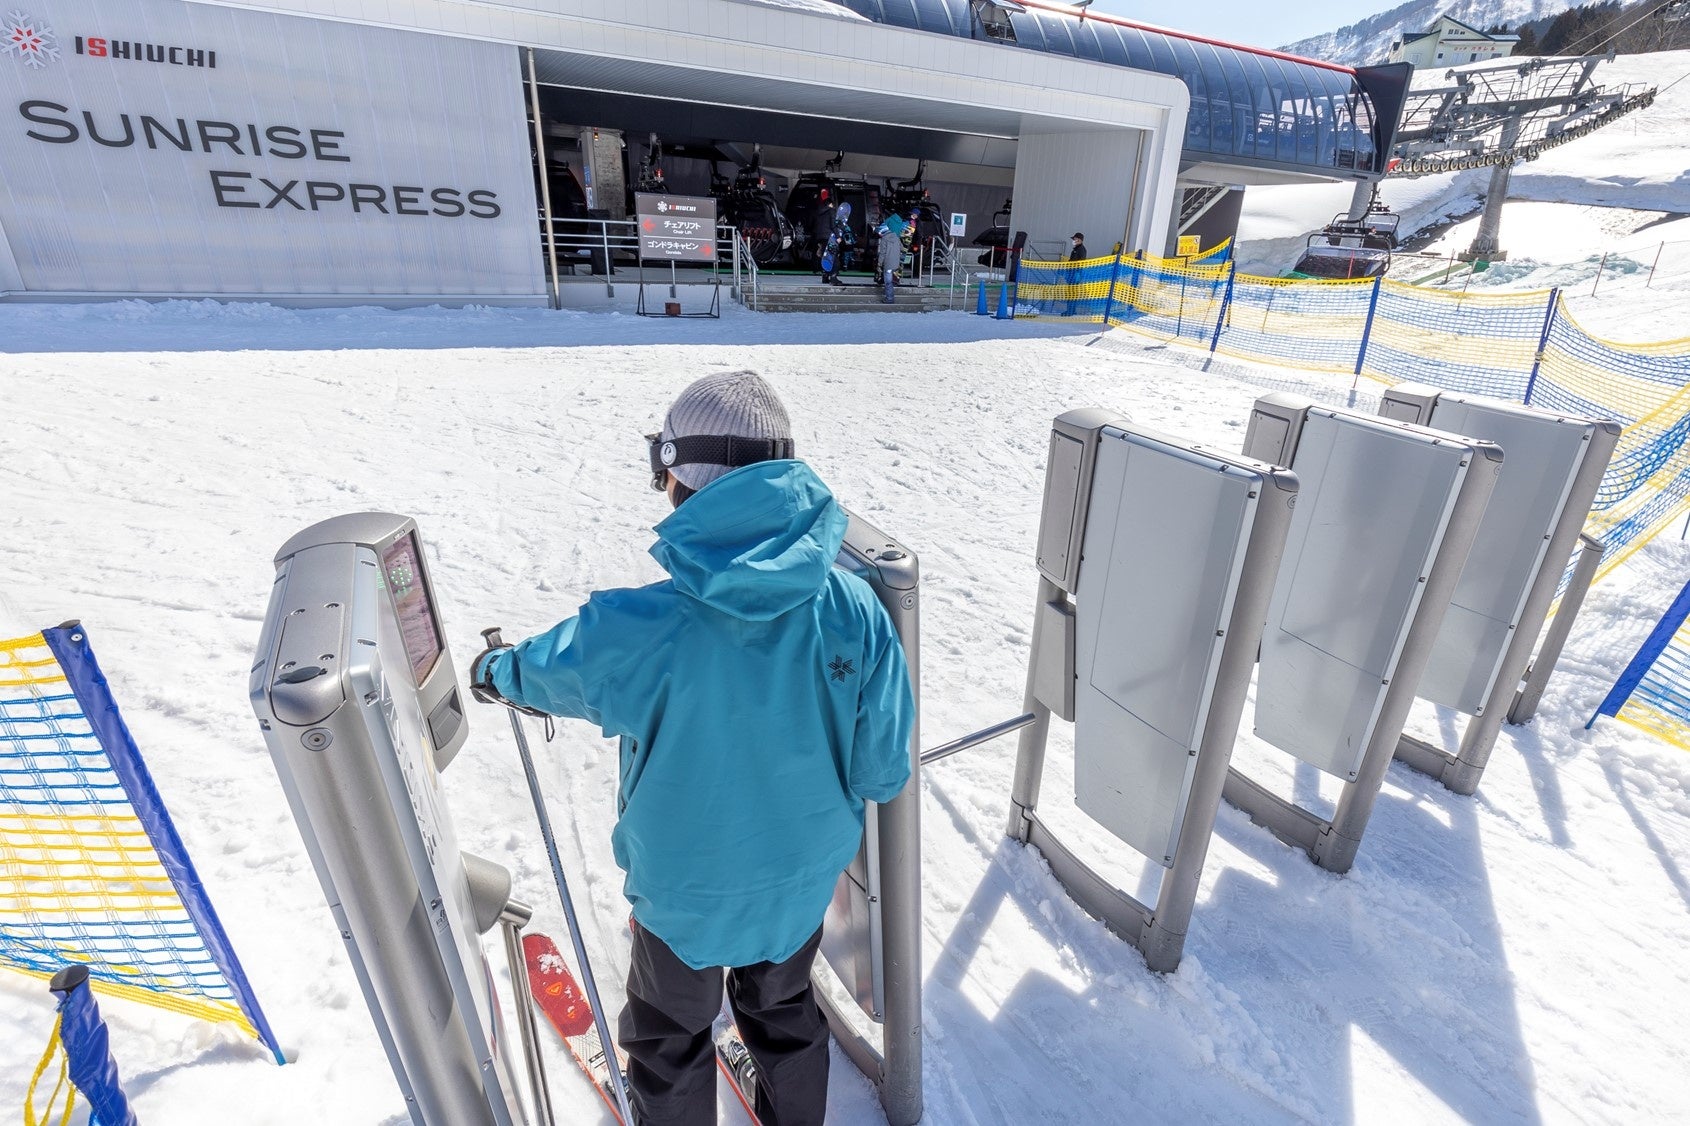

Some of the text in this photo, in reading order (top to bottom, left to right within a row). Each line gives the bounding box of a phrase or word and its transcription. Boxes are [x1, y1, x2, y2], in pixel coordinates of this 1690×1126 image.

[75, 36, 216, 69] ISHIUCHI
[19, 100, 351, 163] SUNRISE
[209, 170, 501, 219] EXPRESS
[663, 220, 701, 230] チェアリフト
[647, 240, 699, 250] ゴンドラキャビン
